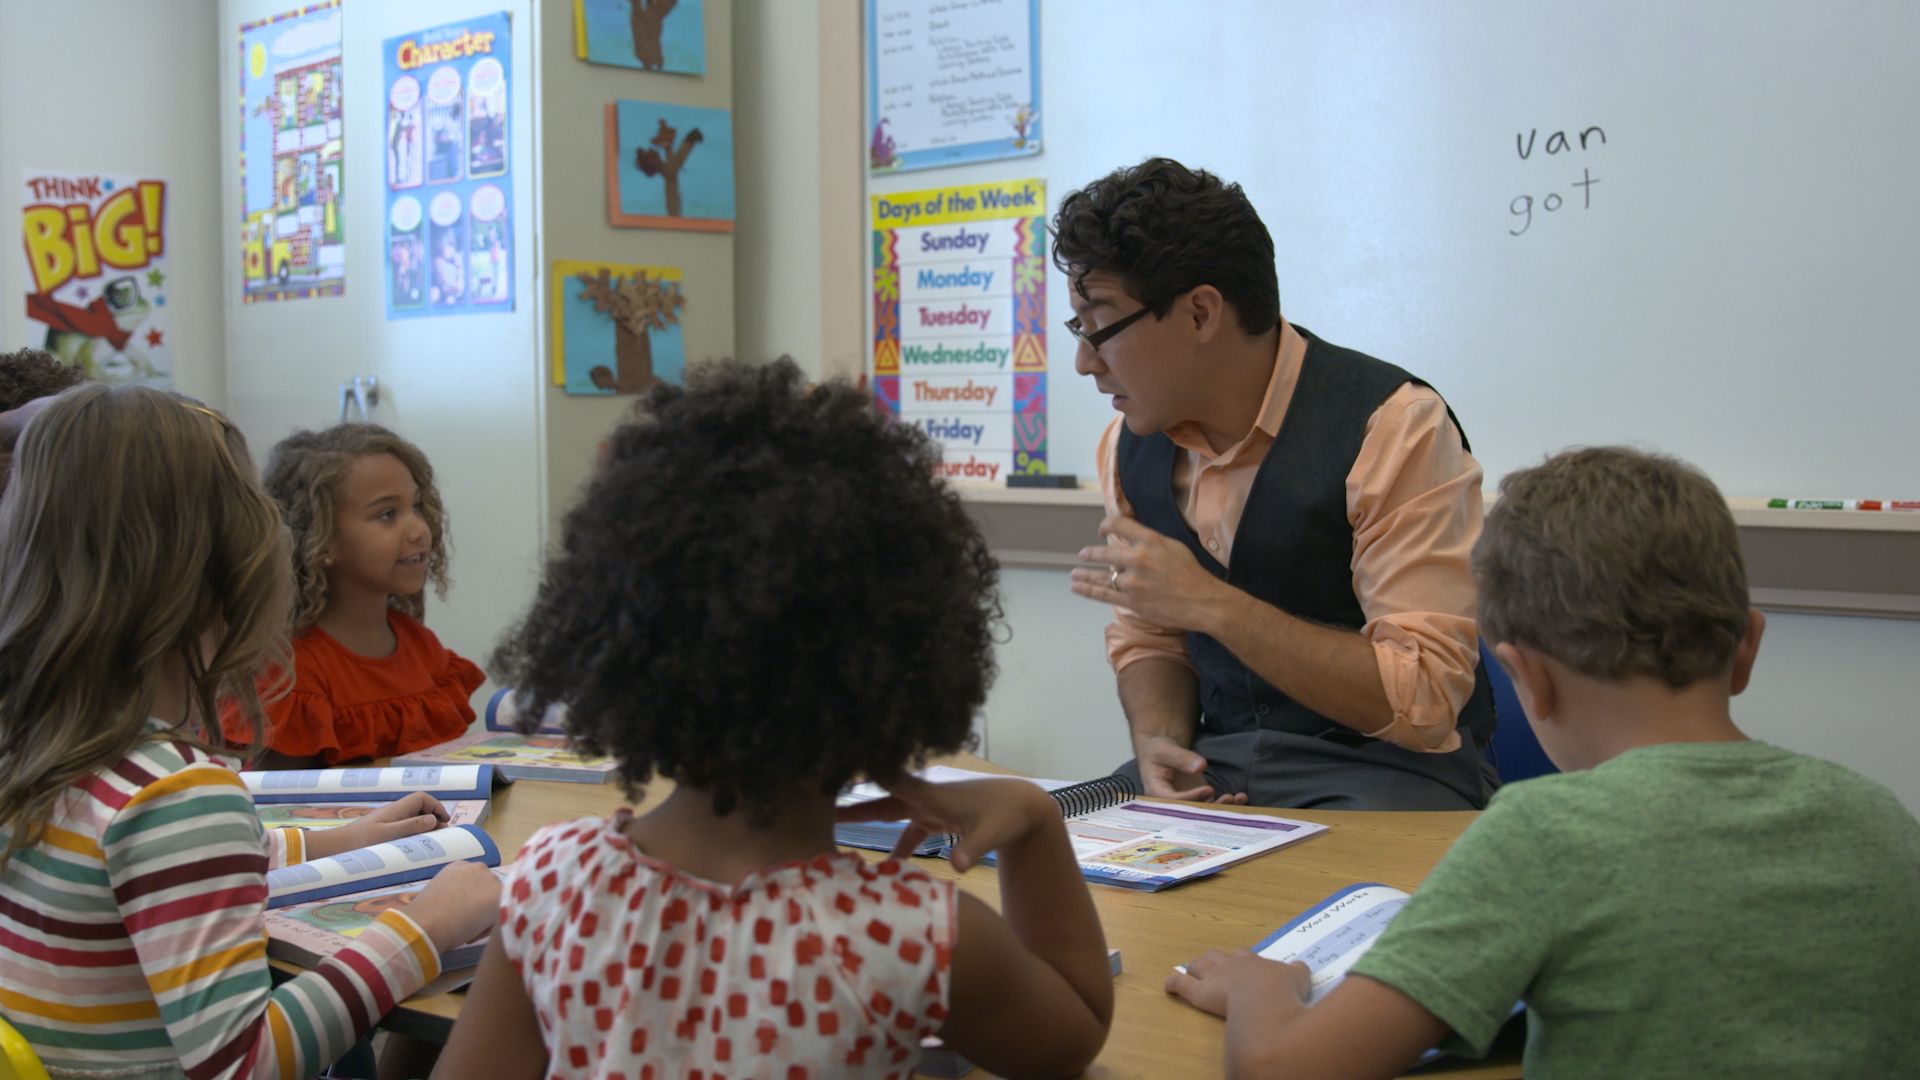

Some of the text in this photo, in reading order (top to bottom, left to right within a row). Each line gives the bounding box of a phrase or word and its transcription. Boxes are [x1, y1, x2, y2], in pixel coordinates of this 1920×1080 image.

[397, 27, 496, 70] Character
[1516, 125, 1606, 160] van
[27, 175, 102, 200] THINK
[1508, 167, 1602, 236] got
[878, 184, 1036, 223] Days of the Week
[920, 226, 990, 255] Sunday
[916, 266, 994, 292] Monday
[918, 304, 991, 330] Tuesday
[902, 341, 1010, 369] Wednesday
[913, 380, 997, 407] Thursday
[926, 418, 985, 445] Friday
[930, 454, 1000, 482] turday
[1295, 892, 1369, 933] Word Works
